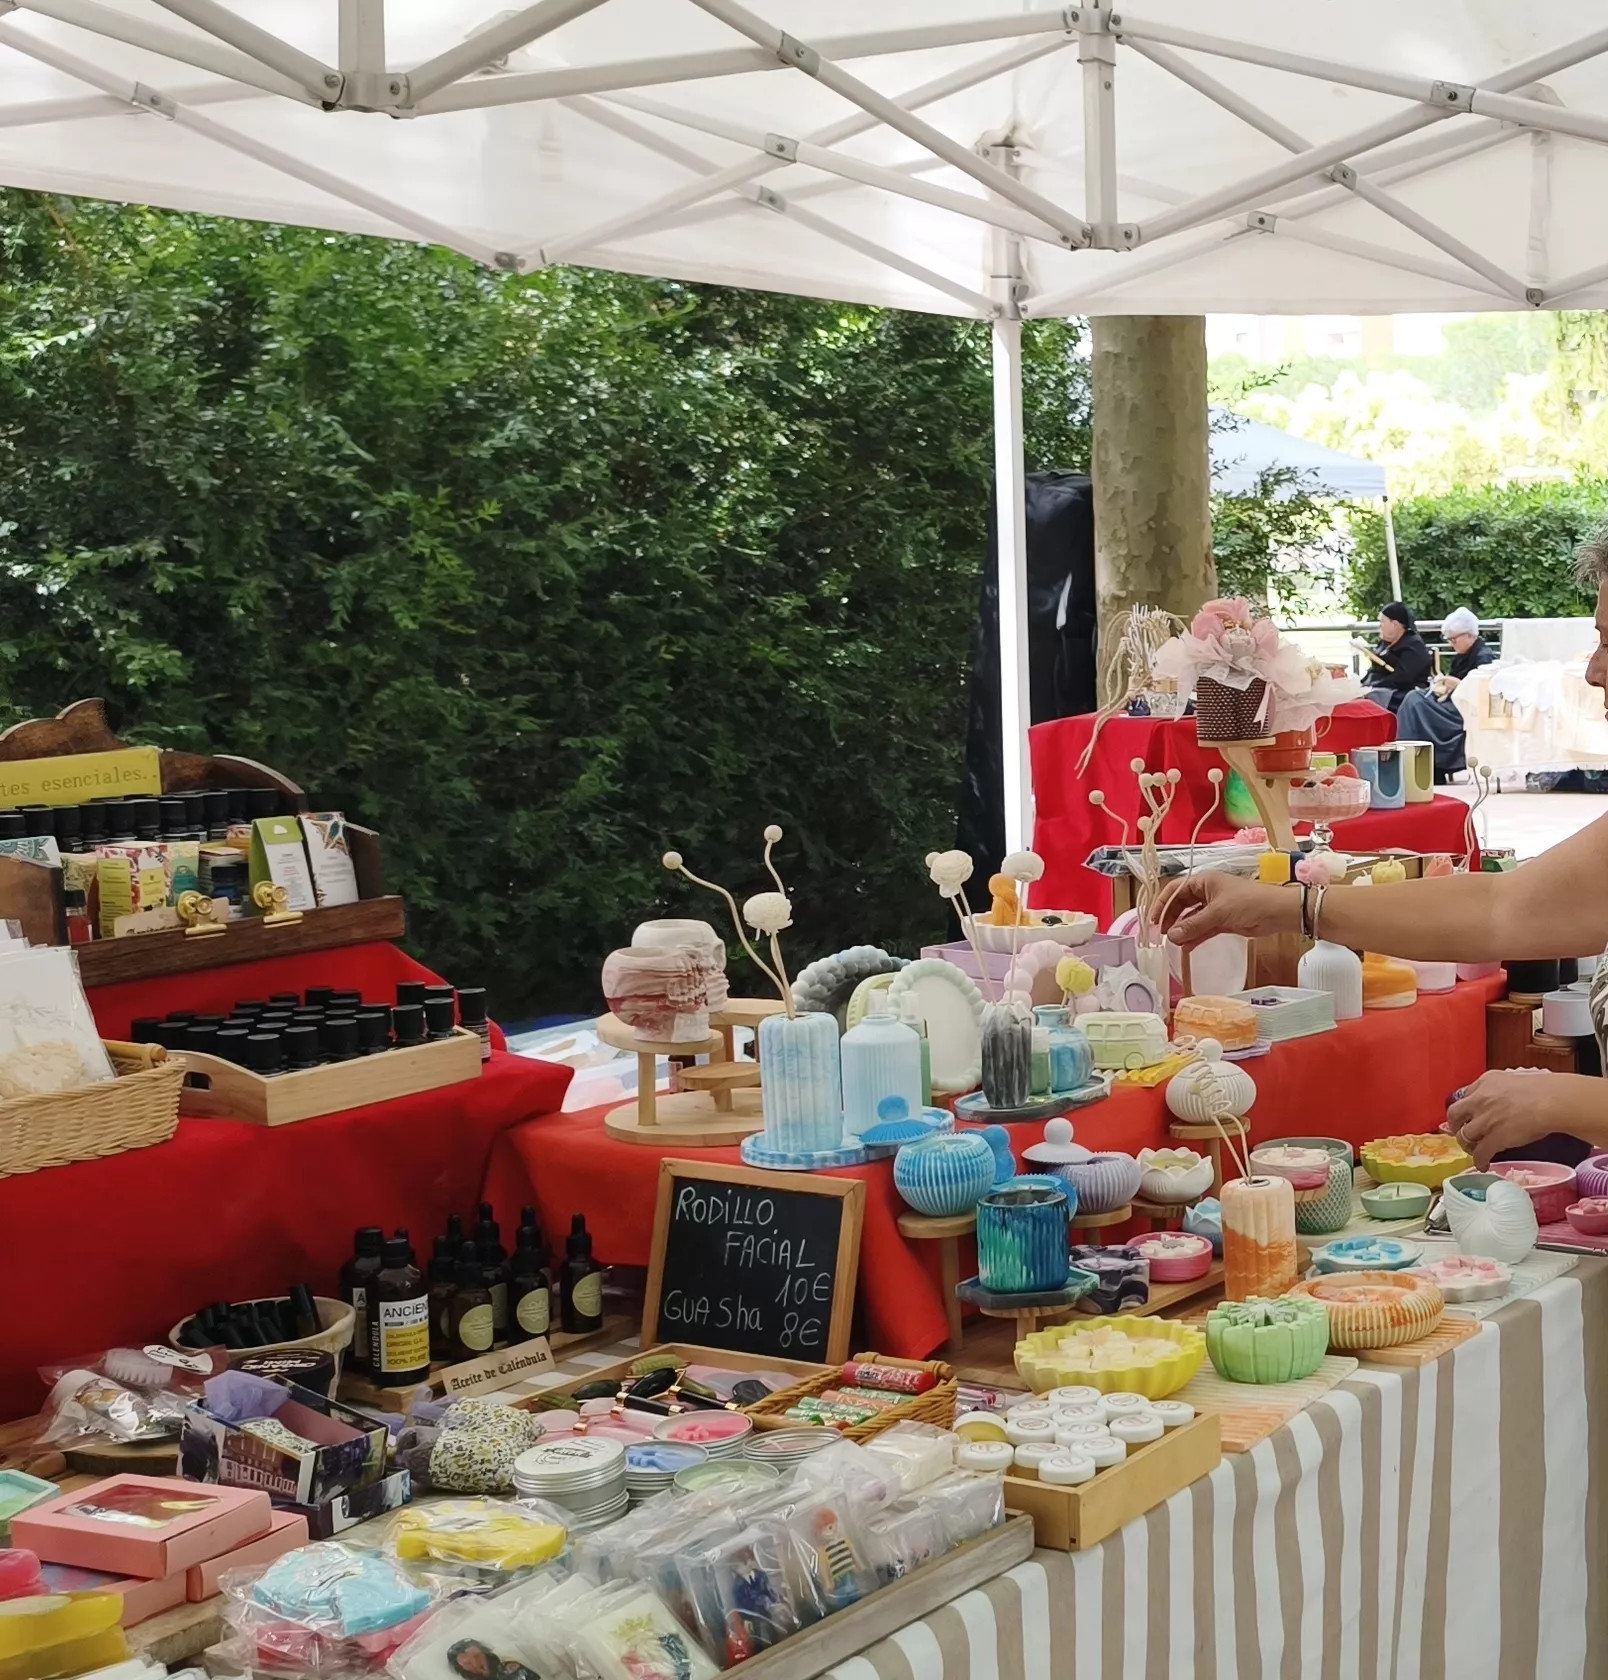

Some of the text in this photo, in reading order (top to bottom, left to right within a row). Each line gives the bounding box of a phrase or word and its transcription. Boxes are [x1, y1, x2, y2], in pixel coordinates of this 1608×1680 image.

[774, 1272, 831, 1308] 10€
[664, 1290, 710, 1326] GUA
[779, 1311, 822, 1348] 8€
[372, 1321, 380, 1368] CALENDULA
[450, 1350, 548, 1391] Aceite de Caléndula
